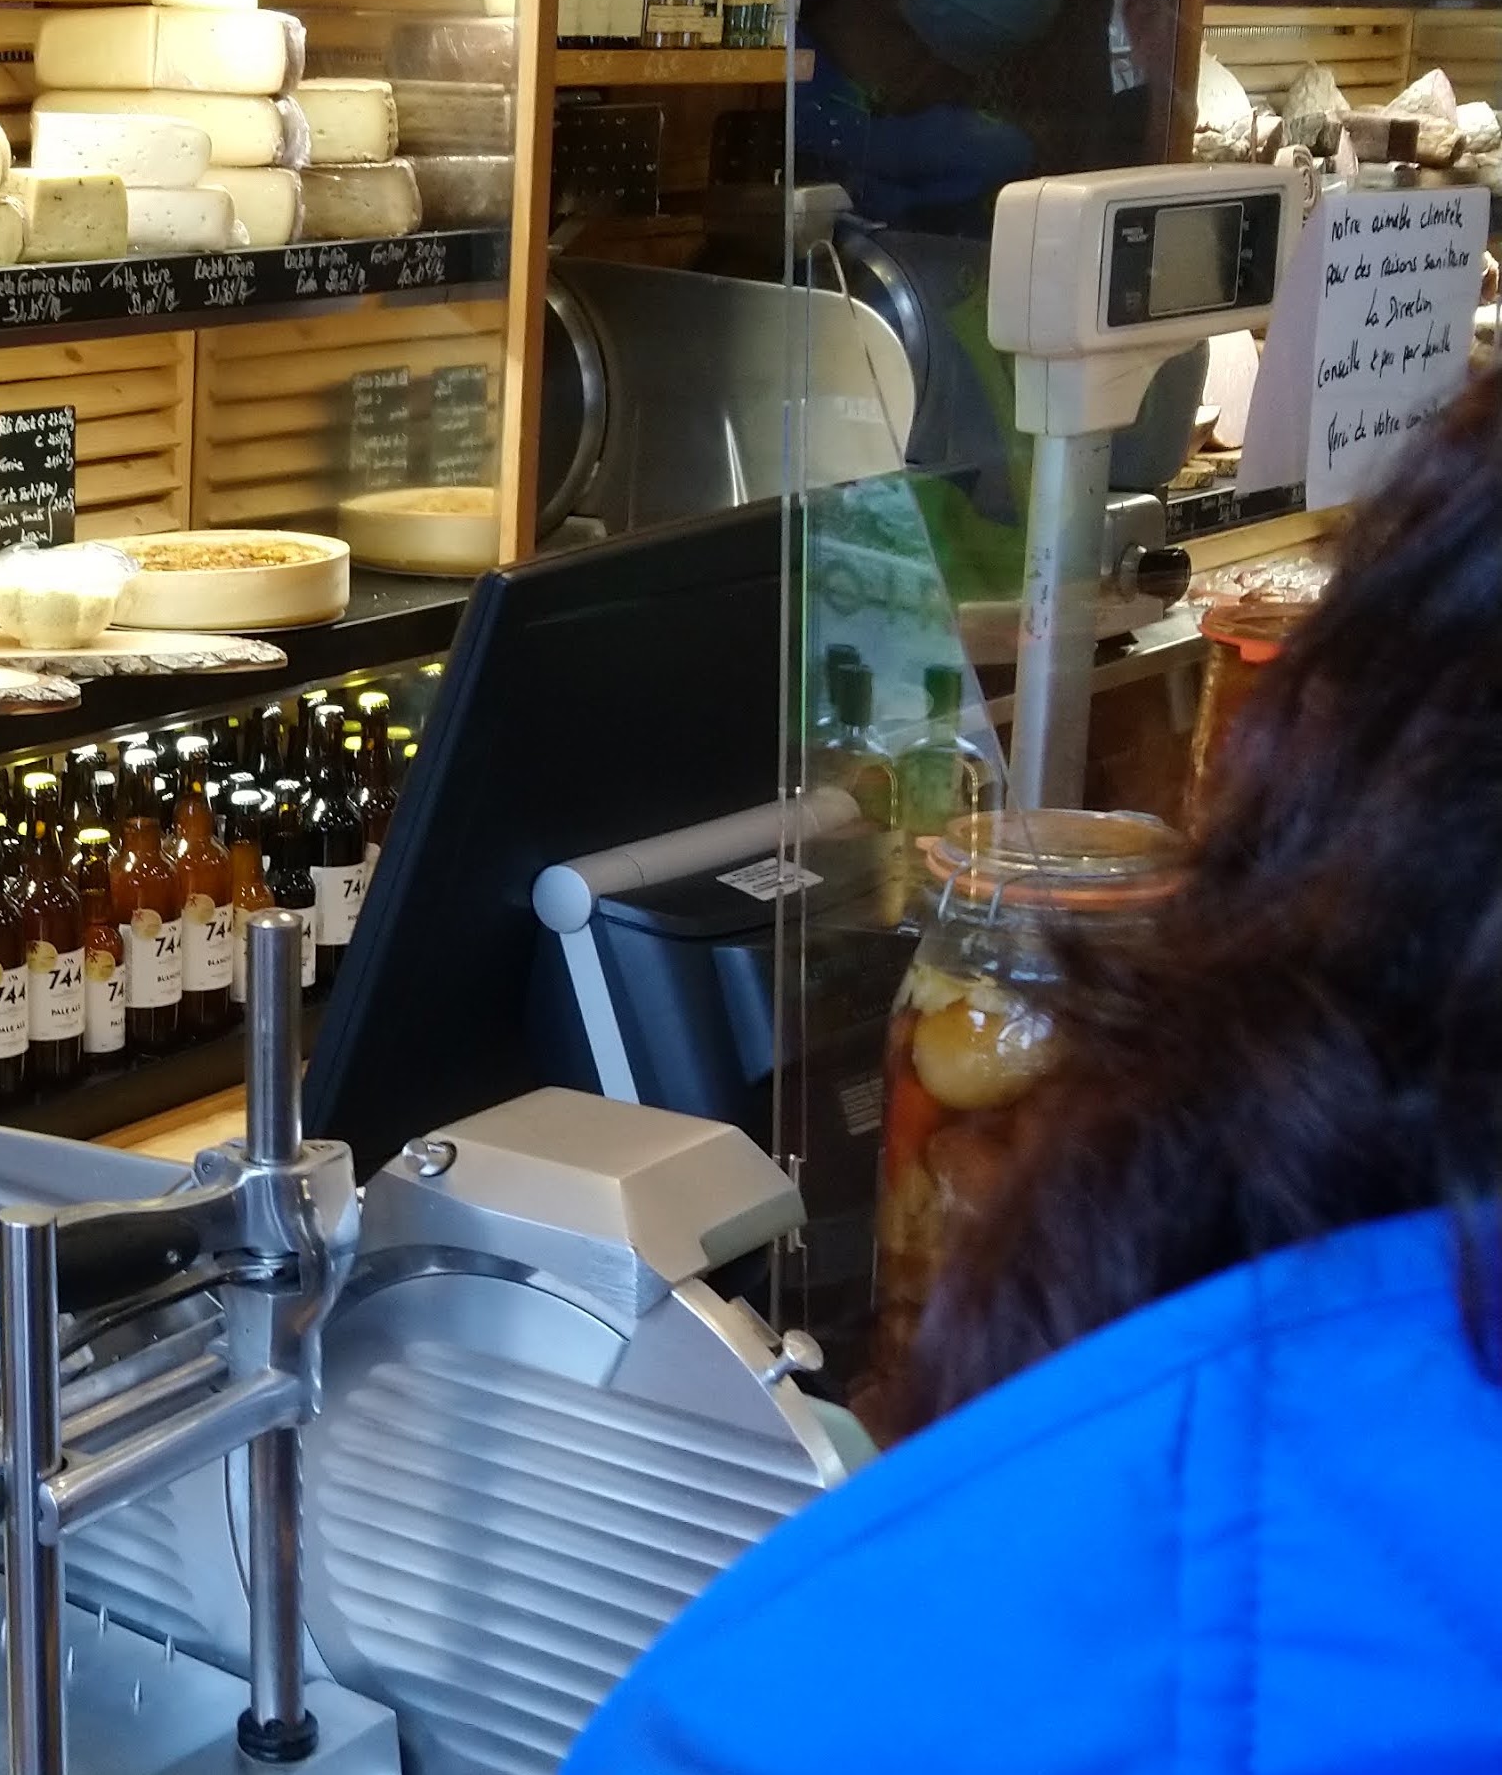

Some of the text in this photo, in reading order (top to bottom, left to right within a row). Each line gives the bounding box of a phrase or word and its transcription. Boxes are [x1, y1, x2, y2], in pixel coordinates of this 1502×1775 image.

[1354, 253, 1371, 281] des
[48, 965, 82, 991] 744
[108, 979, 125, 1003] 74
